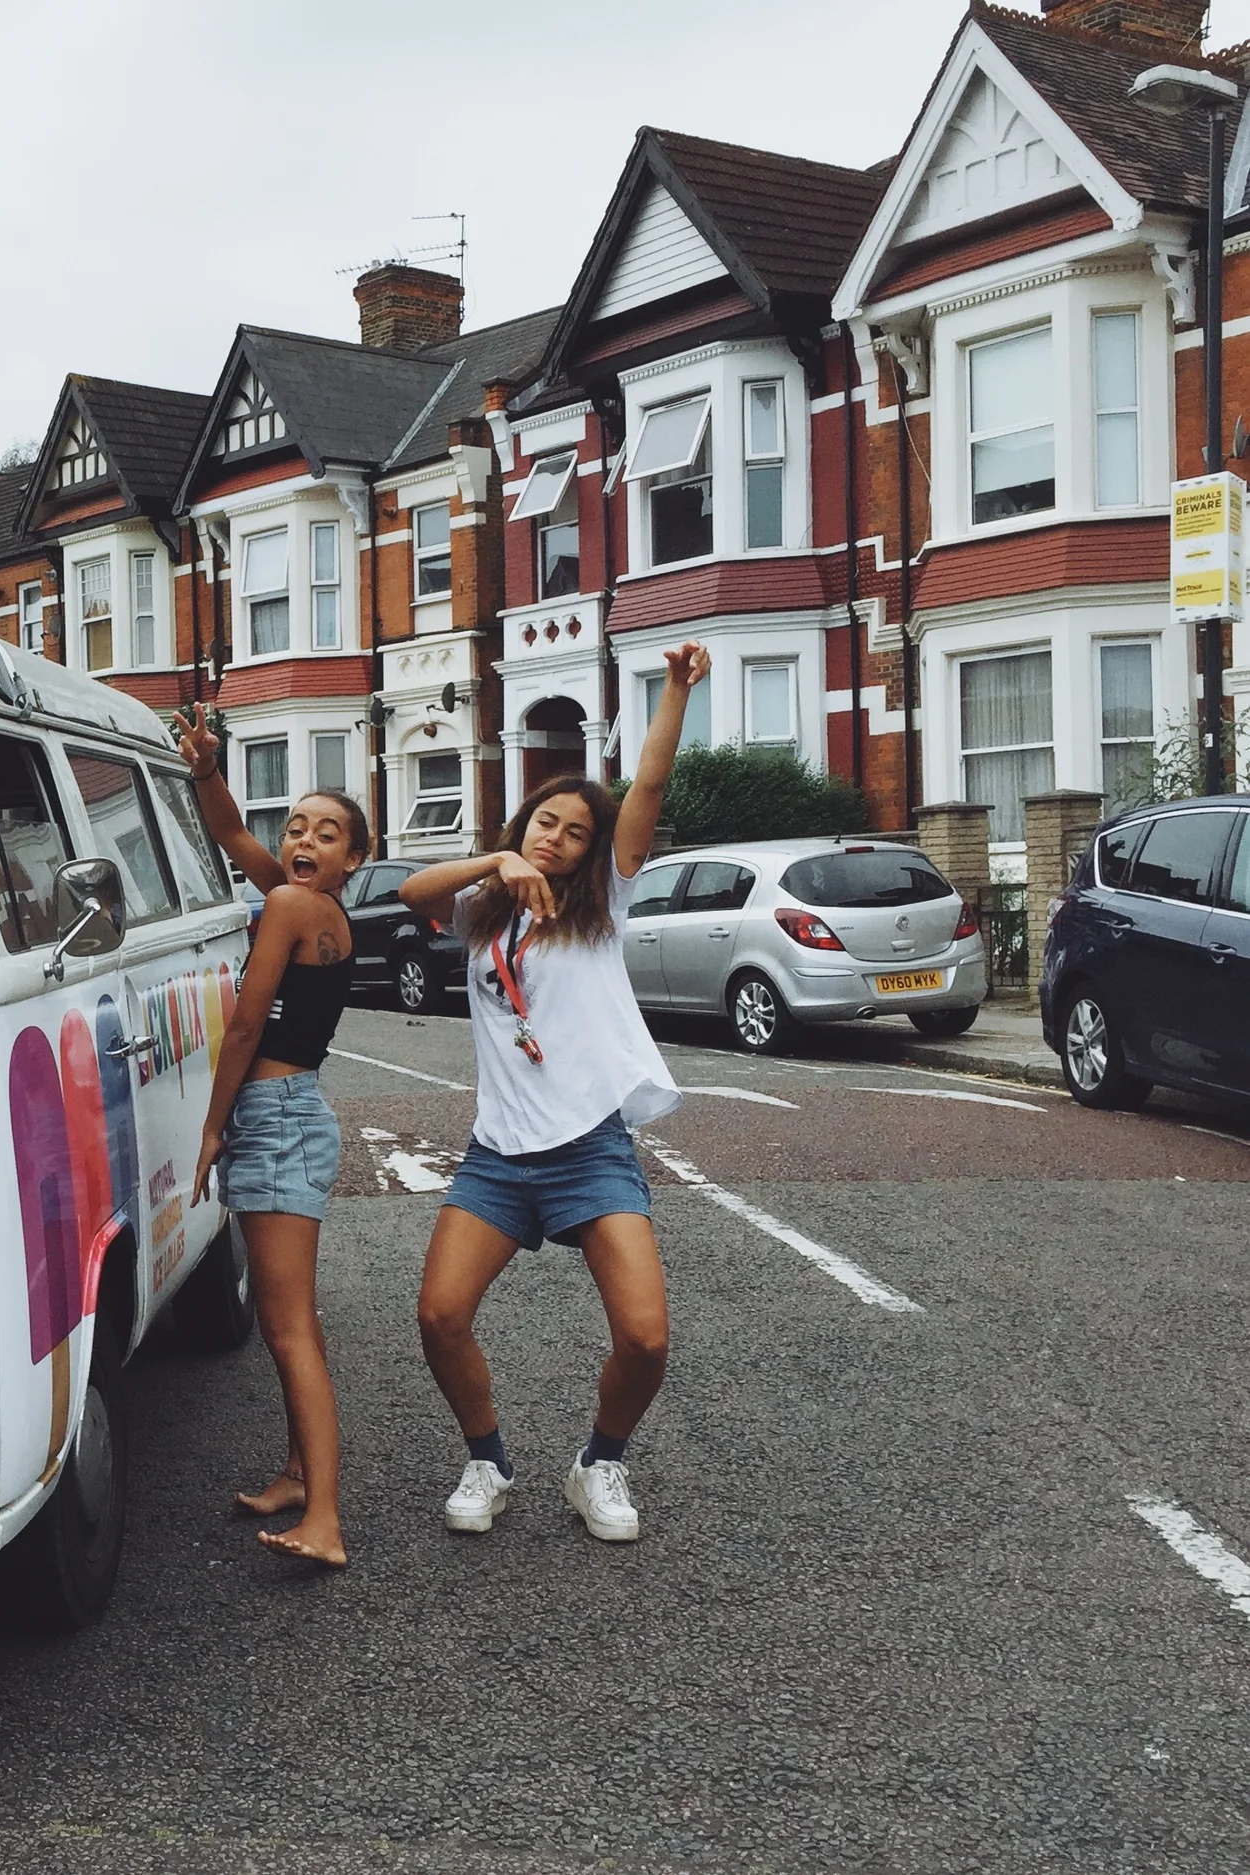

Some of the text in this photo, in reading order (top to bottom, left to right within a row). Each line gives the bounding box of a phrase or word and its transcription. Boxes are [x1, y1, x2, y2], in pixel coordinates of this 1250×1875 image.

[1176, 491, 1222, 505] CRIMINALS
[1176, 499, 1222, 515] BEWARE
[881, 972, 938, 990] DY60 MYK
